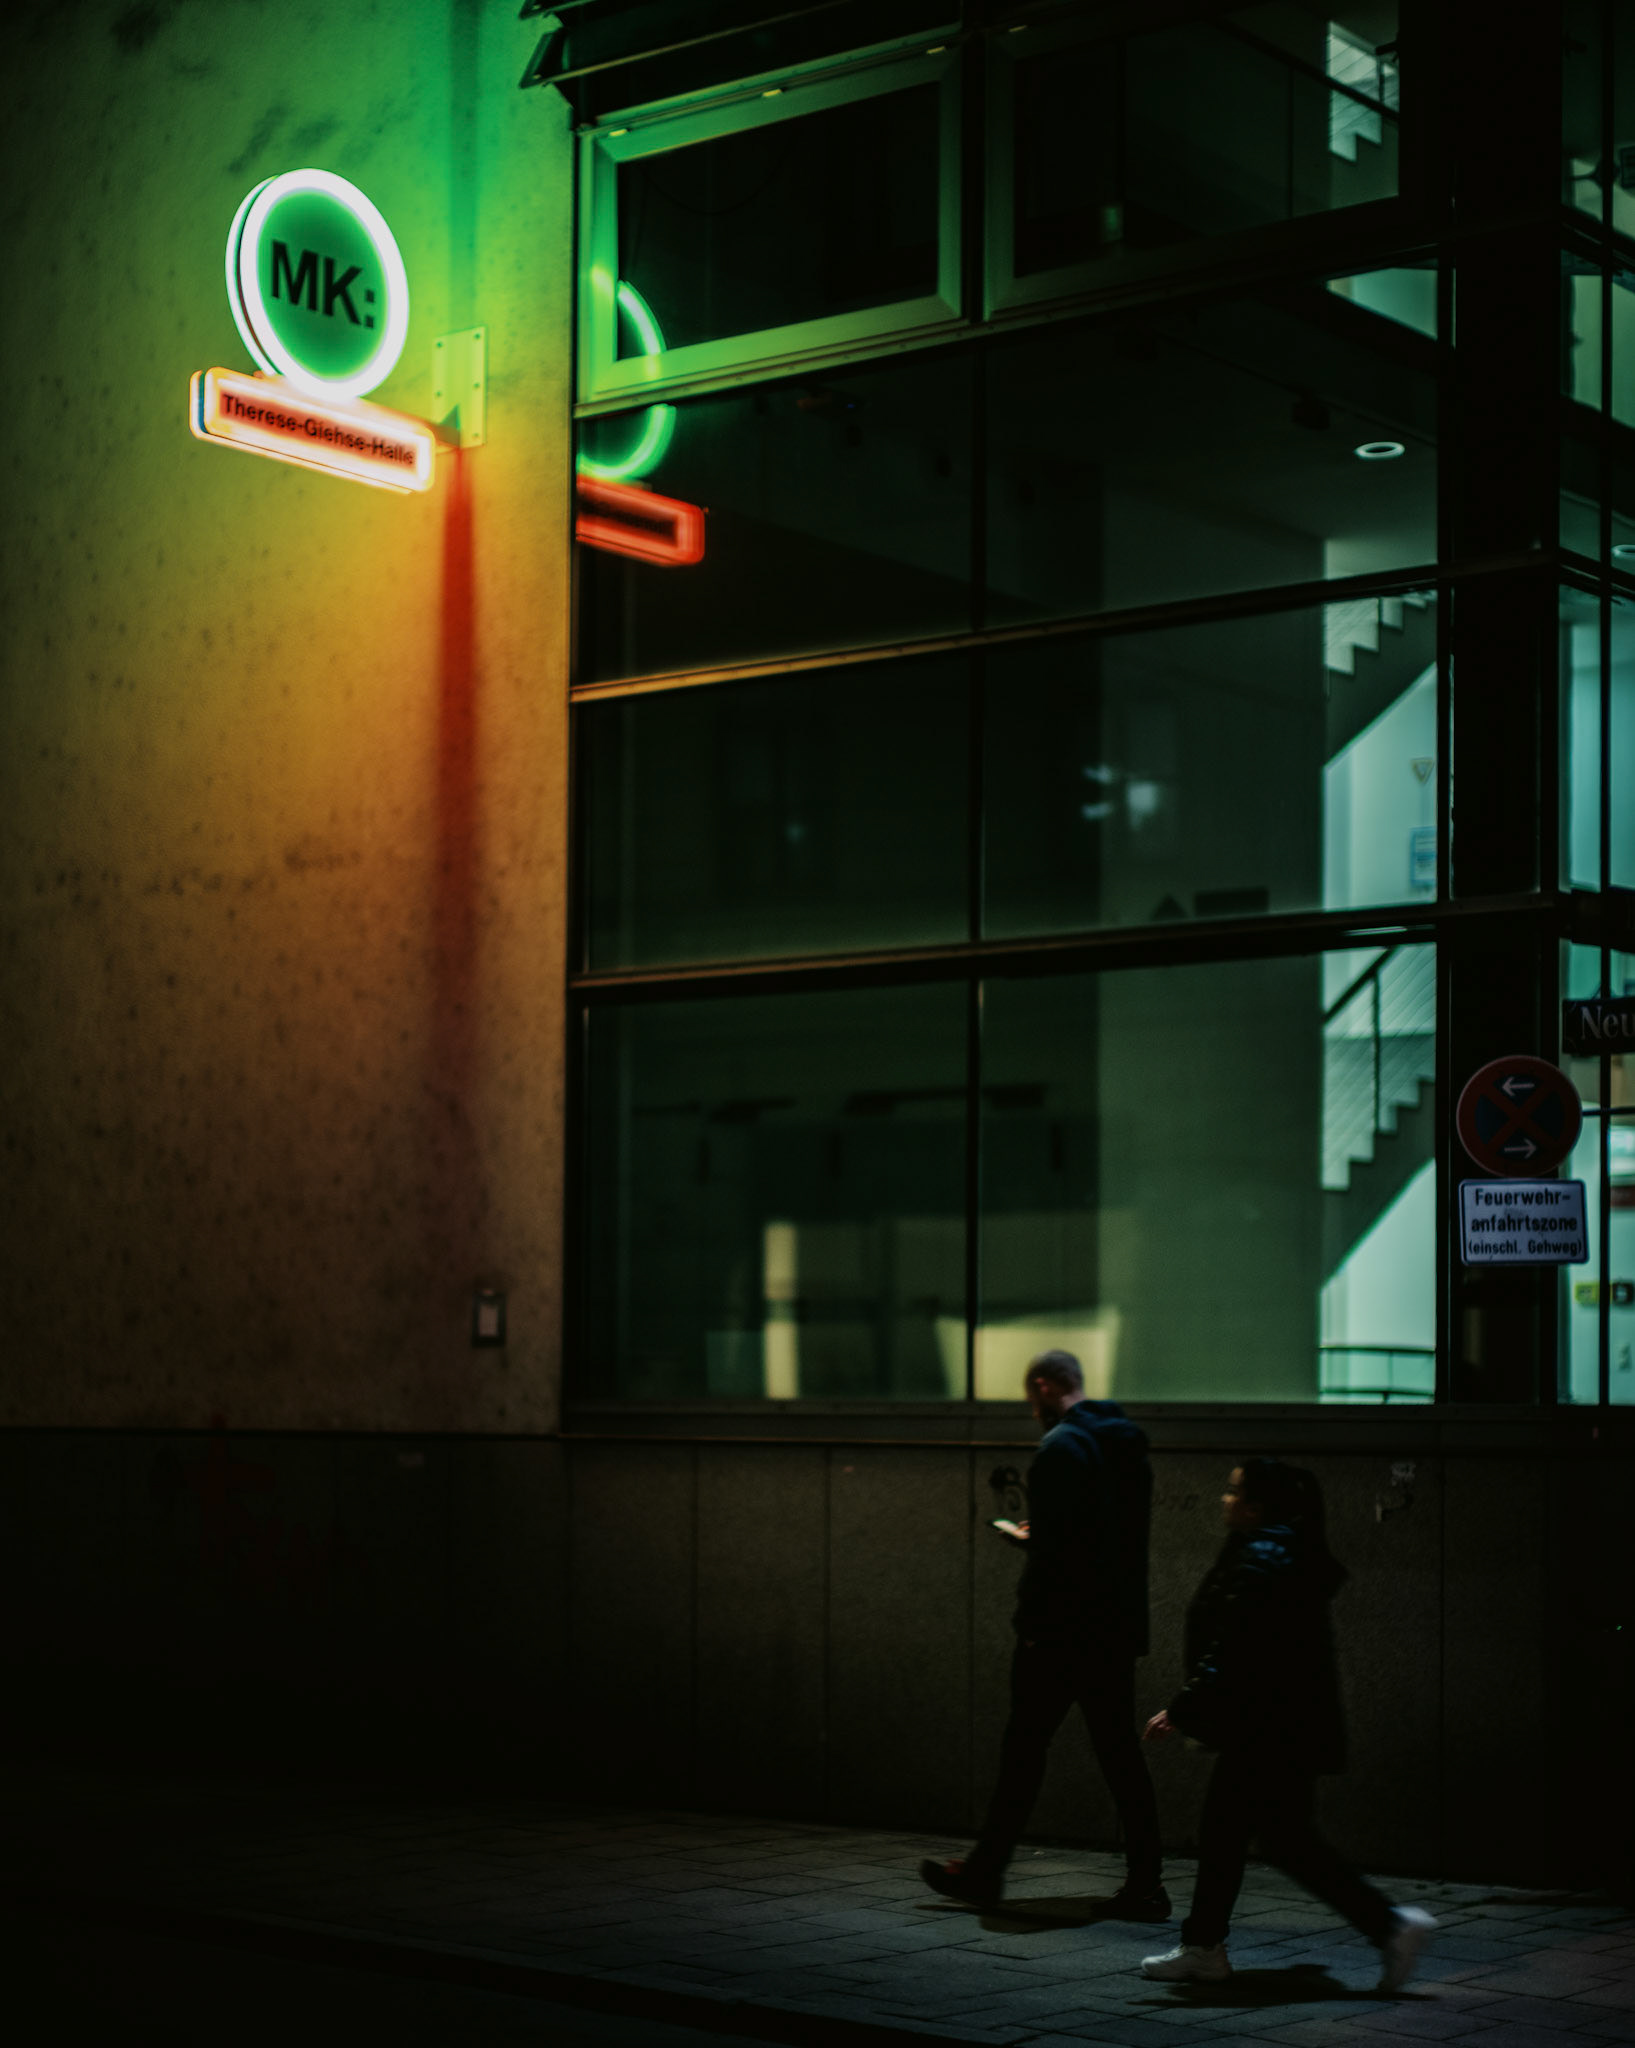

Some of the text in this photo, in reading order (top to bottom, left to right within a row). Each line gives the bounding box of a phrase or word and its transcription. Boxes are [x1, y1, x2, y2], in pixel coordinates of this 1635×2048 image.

[271, 239, 376, 329] MK:
[223, 393, 416, 466] Therese-Giehse-Halle
[1475, 1187, 1571, 1206] Feuerwehr-
[1471, 1214, 1577, 1232] anfahrtszone
[1468, 1239, 1583, 1257] (einschl. Gehweg)
